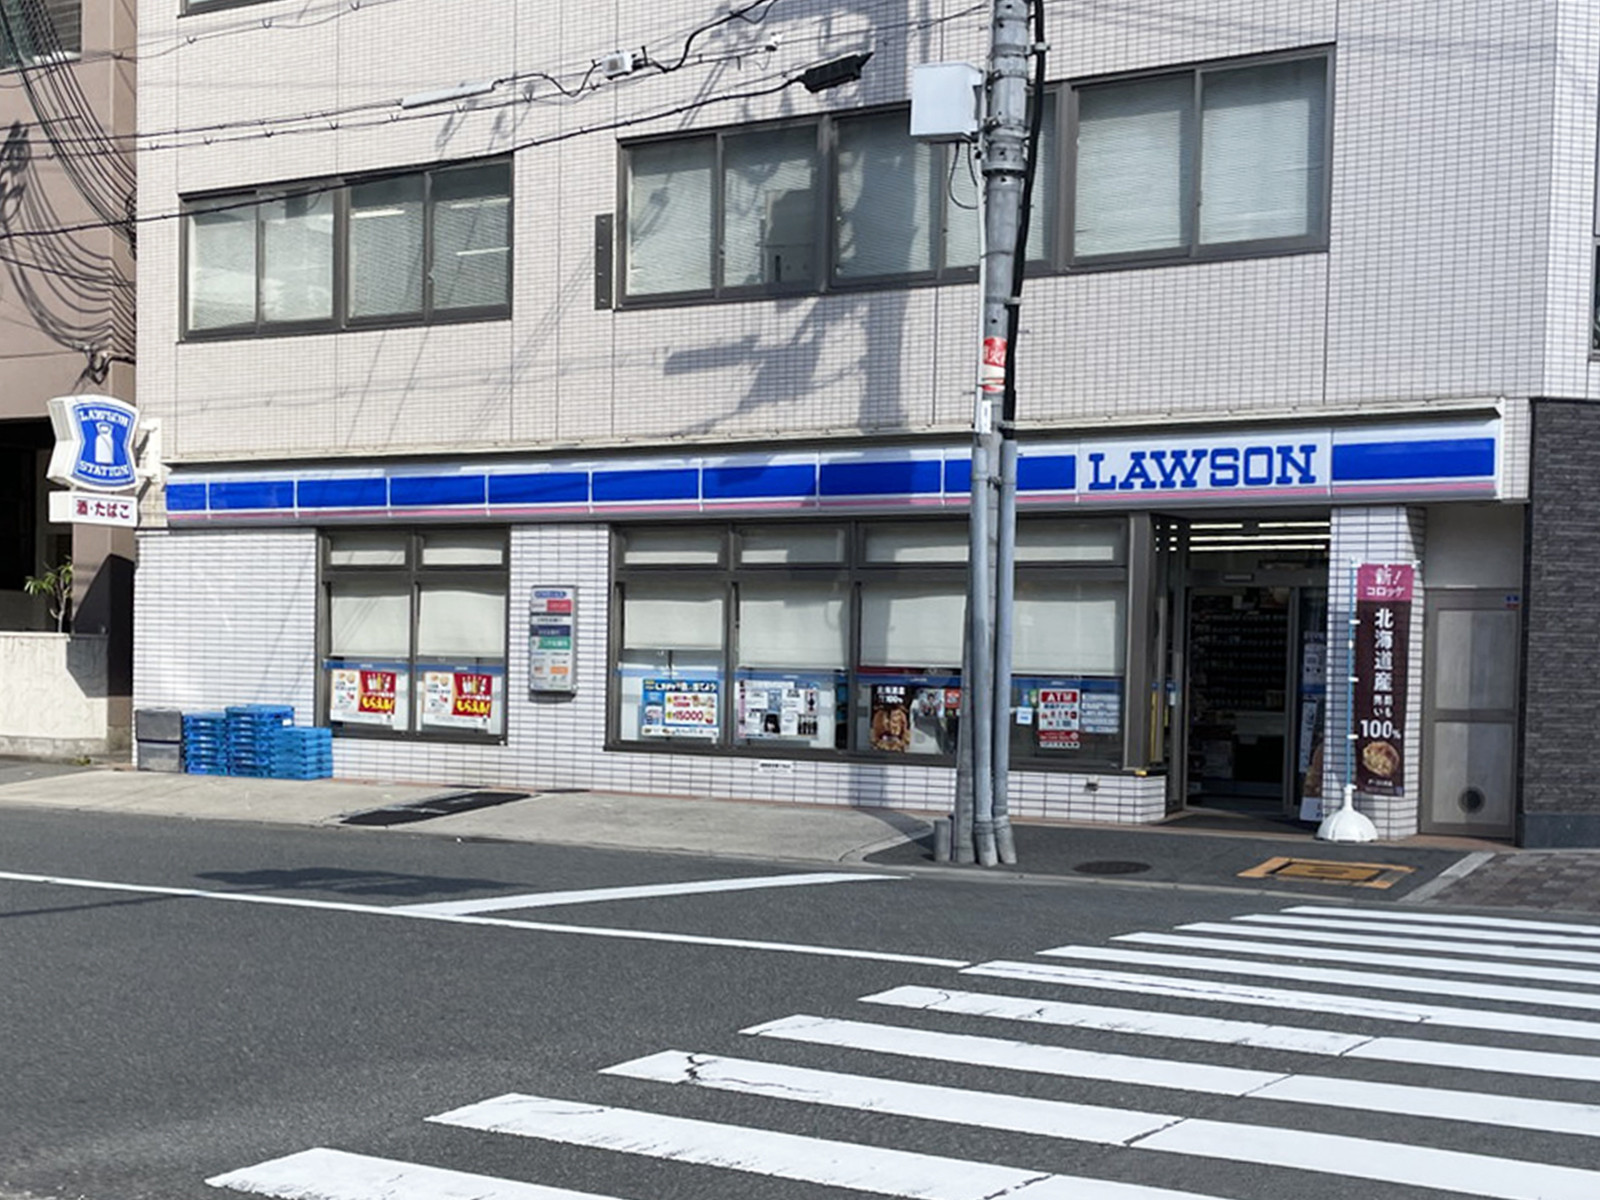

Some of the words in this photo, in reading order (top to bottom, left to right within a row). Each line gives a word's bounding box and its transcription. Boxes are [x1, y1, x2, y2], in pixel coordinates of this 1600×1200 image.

[80, 408, 129, 427] LAWSON
[80, 461, 130, 477] STATION
[1088, 445, 1317, 491] LAWSON
[1366, 586, 1405, 597] コロッケ
[1374, 608, 1394, 691] 北海道産
[1046, 691, 1074, 703] ATM
[1360, 719, 1401, 739] 100%
